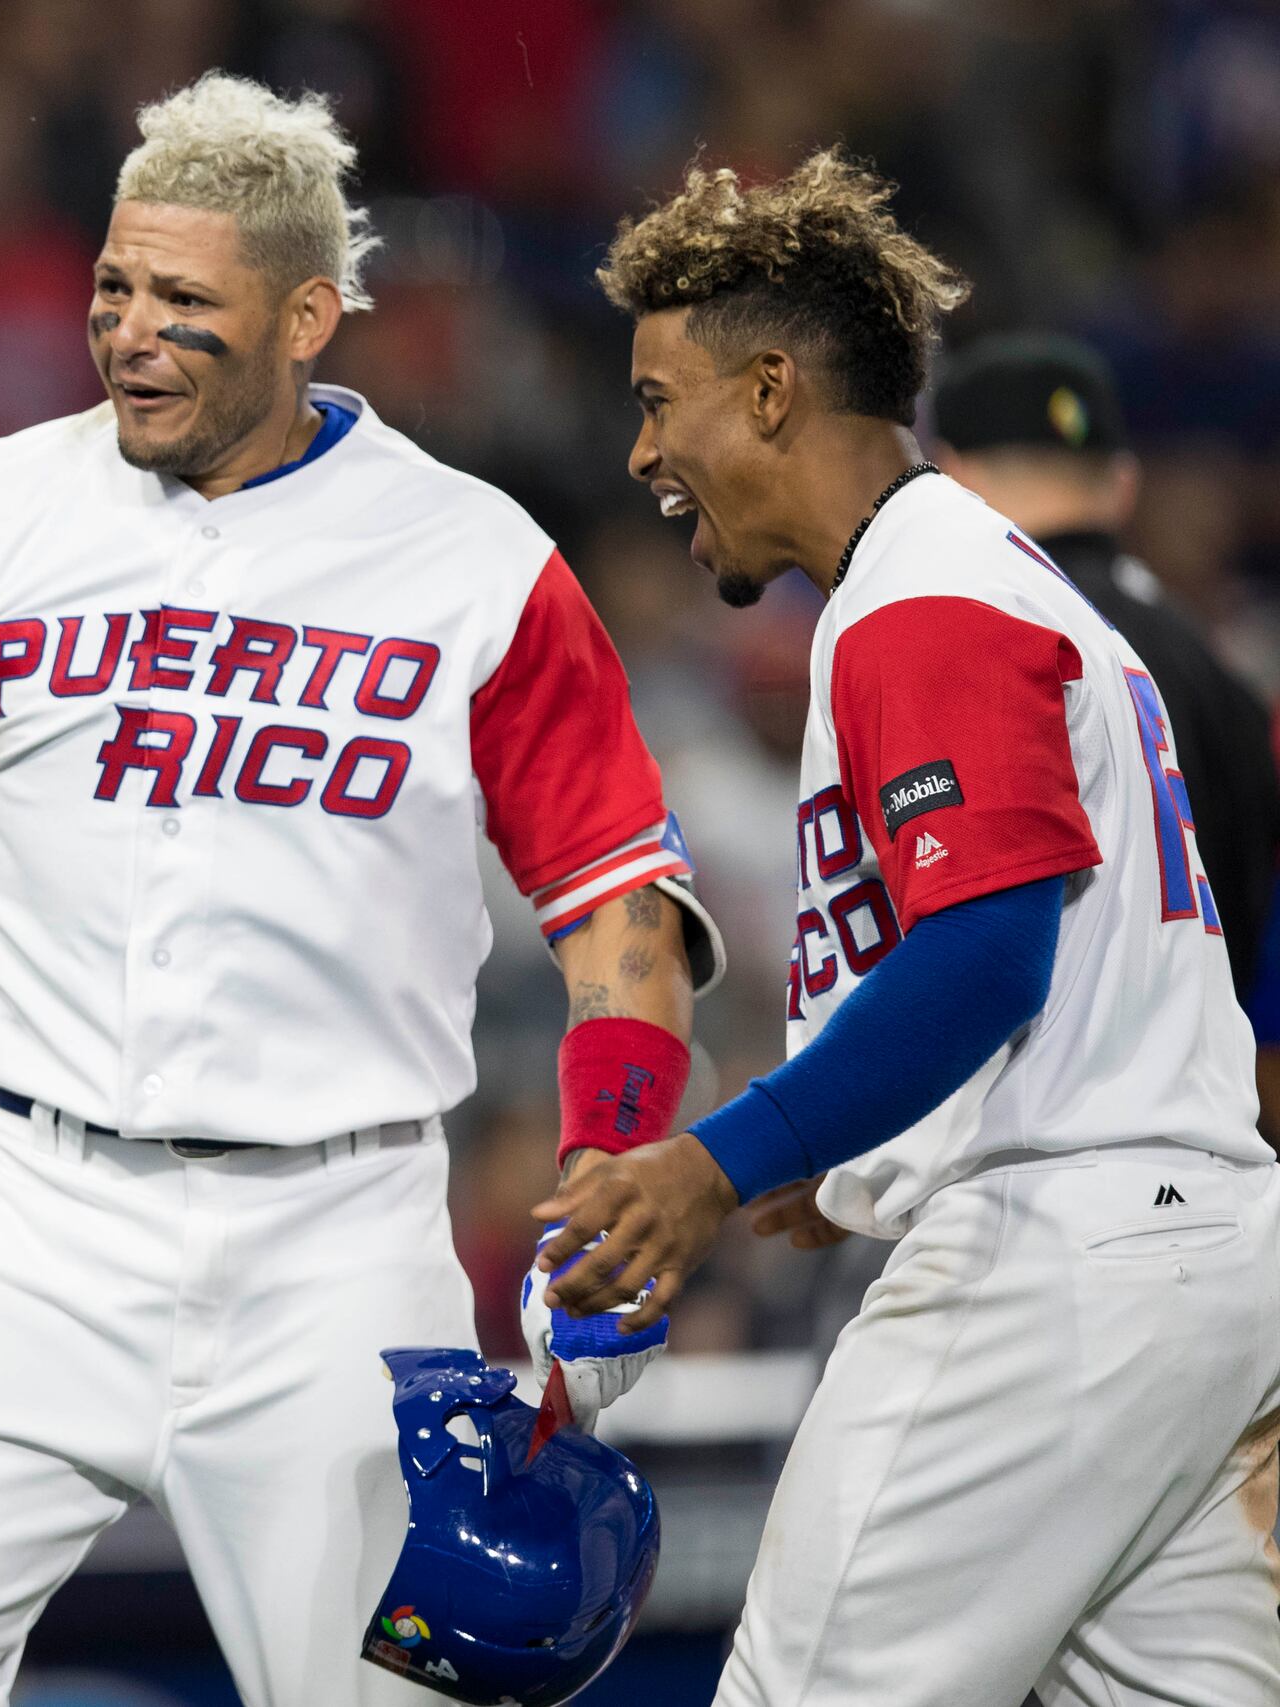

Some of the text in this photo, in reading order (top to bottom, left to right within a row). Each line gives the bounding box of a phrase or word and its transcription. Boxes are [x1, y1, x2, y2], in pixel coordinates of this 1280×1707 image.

[93, 704, 412, 820] RICO
[915, 849, 949, 870] Majestic
[424, 1657, 460, 1682] 4
